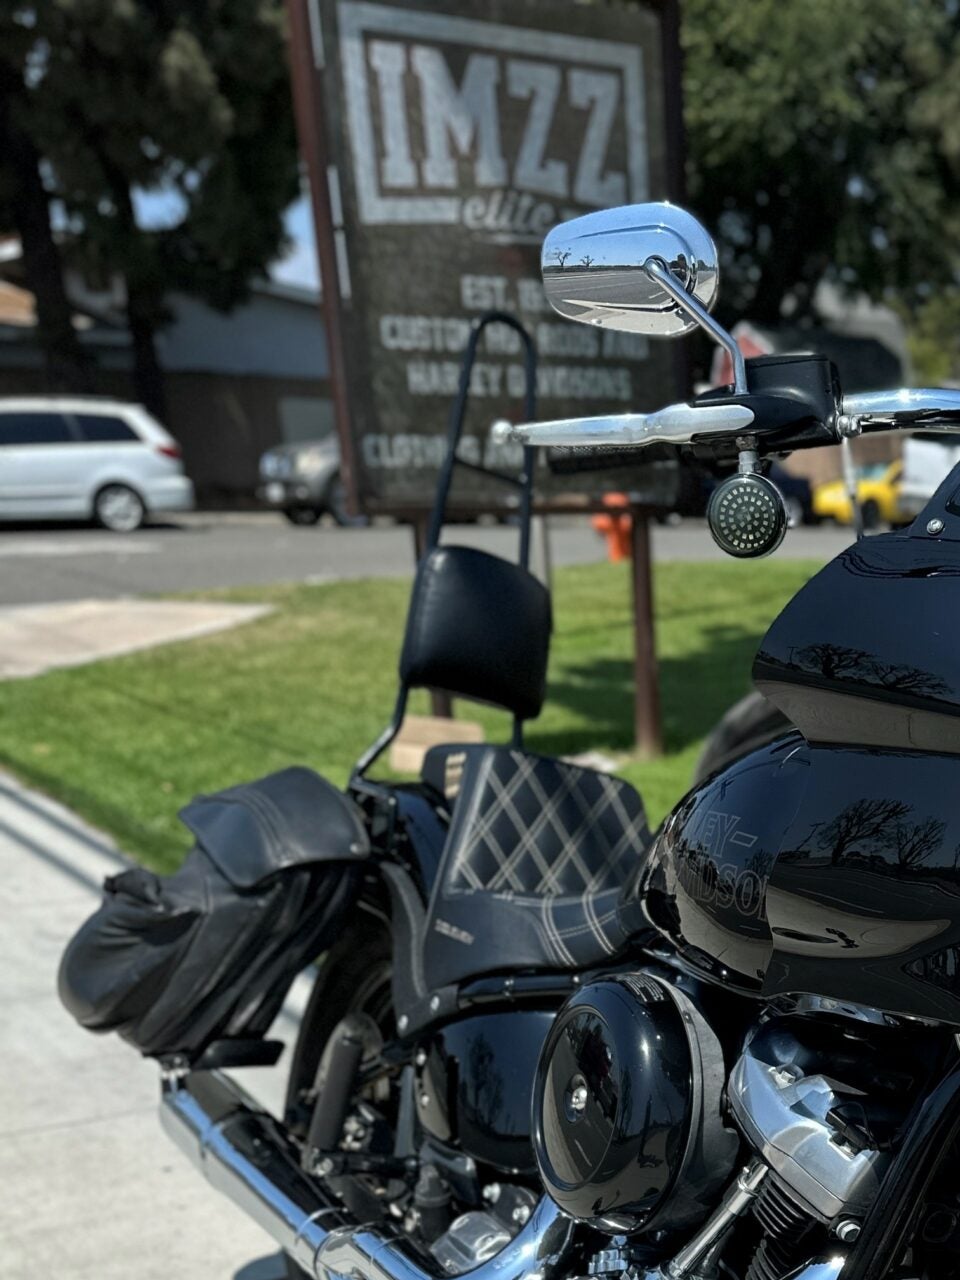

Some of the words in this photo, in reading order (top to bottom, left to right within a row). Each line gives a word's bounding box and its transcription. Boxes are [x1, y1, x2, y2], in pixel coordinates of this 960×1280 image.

[368, 37, 629, 207] IMZZ
[407, 361, 502, 397] HAREY
[507, 364, 633, 401] DVIDSONS
